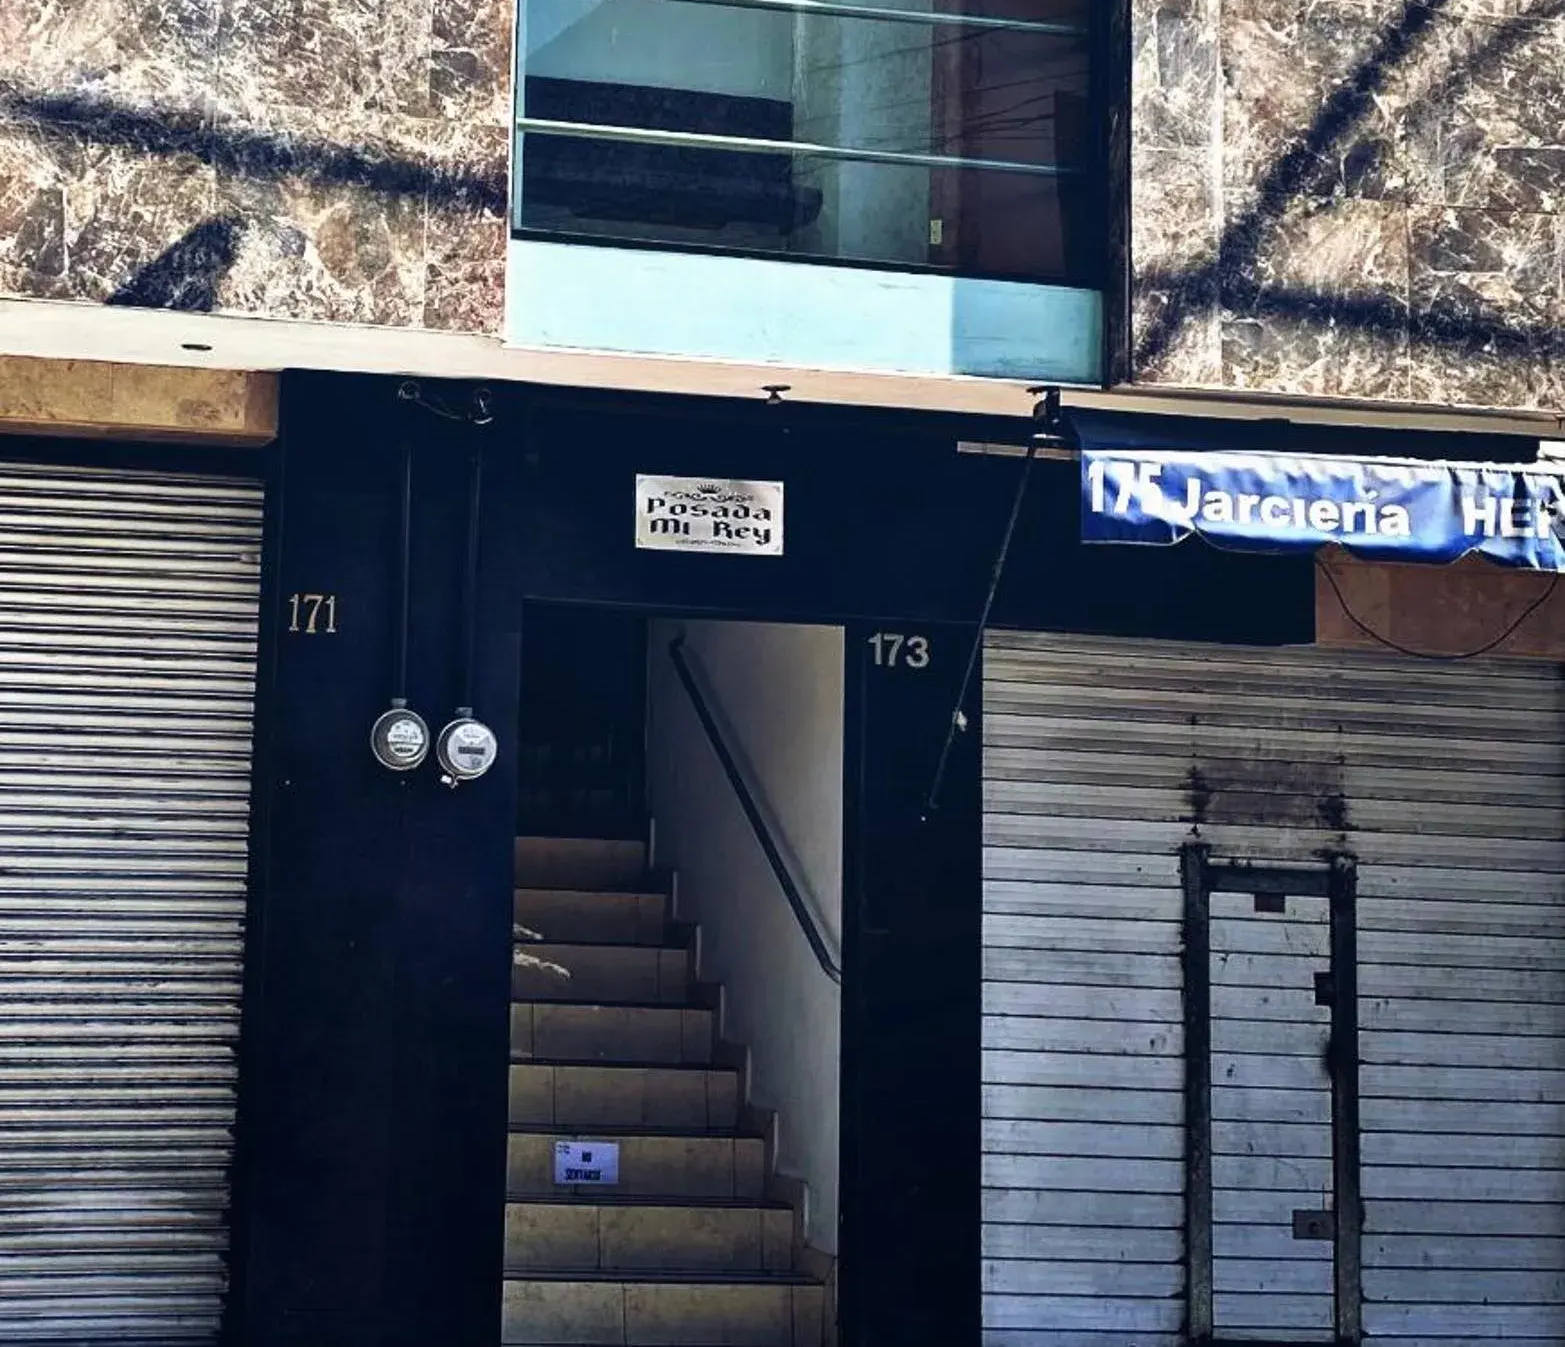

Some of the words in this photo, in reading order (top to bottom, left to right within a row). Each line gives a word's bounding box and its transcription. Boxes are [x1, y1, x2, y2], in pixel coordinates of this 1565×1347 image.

[647, 497, 771, 521] Posada
[713, 520, 771, 546] Rey
[289, 593, 337, 633] 171
[868, 633, 930, 668] 173
